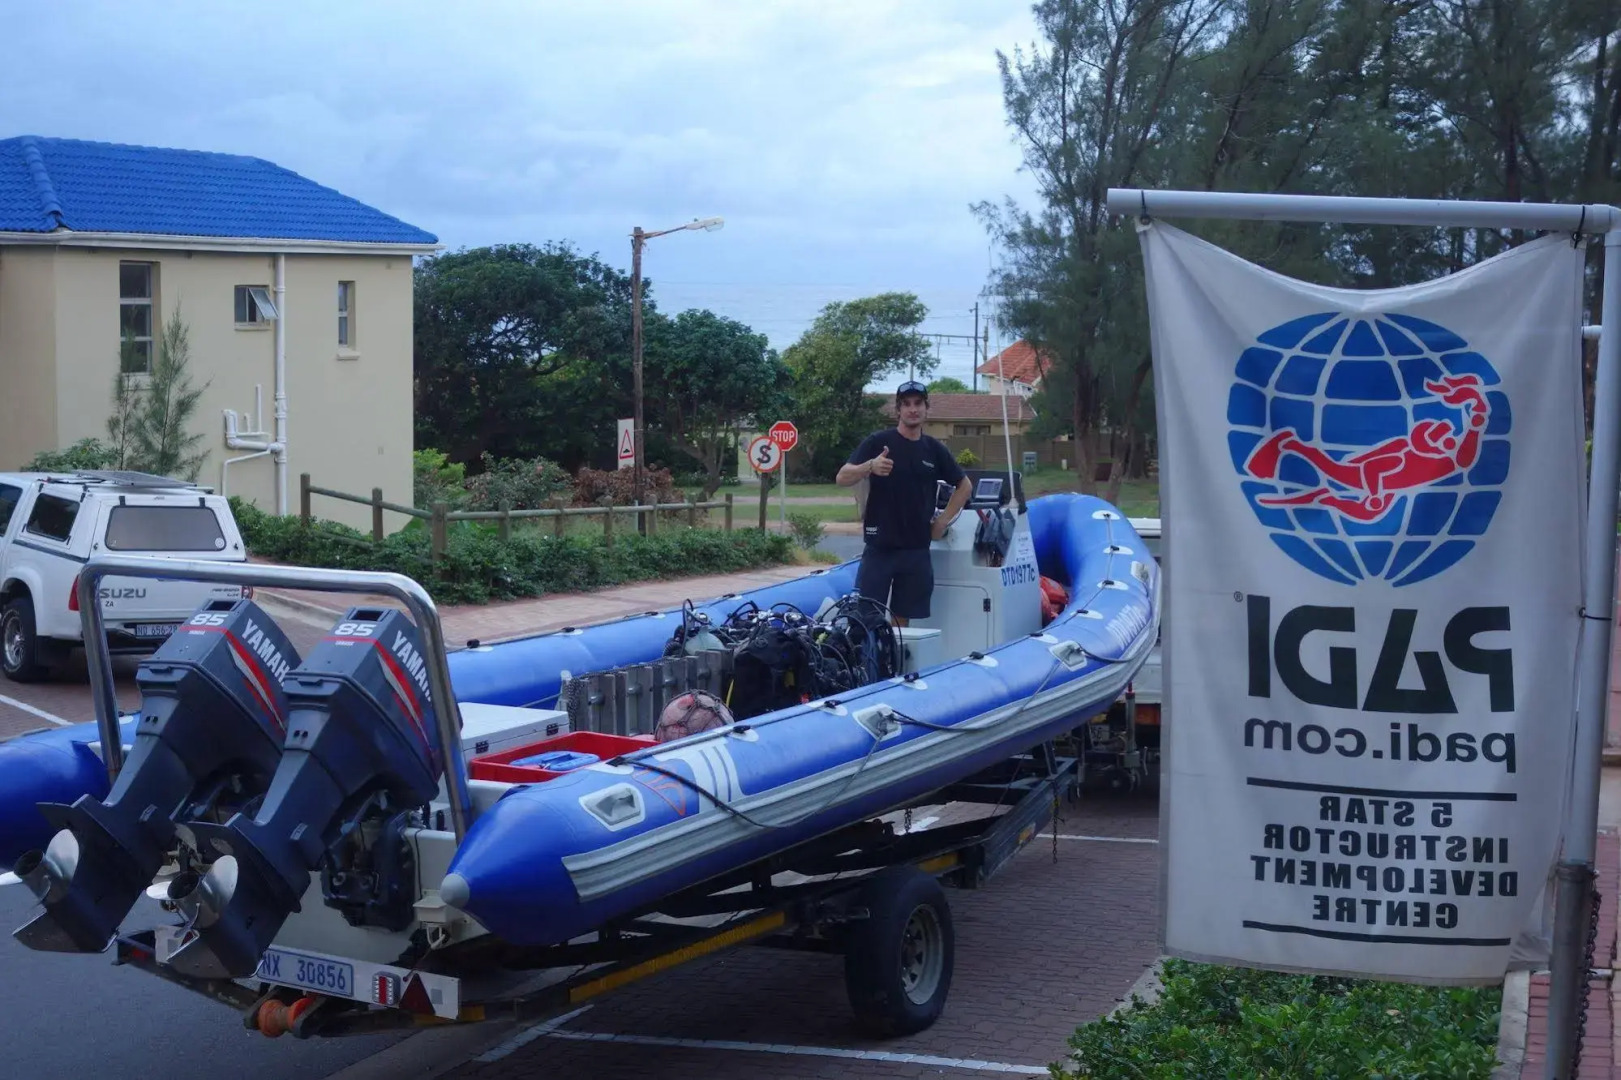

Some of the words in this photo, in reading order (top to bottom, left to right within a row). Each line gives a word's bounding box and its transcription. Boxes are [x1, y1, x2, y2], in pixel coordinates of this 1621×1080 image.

[772, 430, 795, 442] STOP
[757, 444, 772, 464] S
[99, 587, 147, 599] SUZU
[104, 600, 115, 608] ZA
[189, 613, 229, 626] 85
[334, 623, 377, 637] 85
[241, 618, 290, 688] YAMAH
[262, 953, 281, 978] NX
[297, 959, 346, 990] 30856
